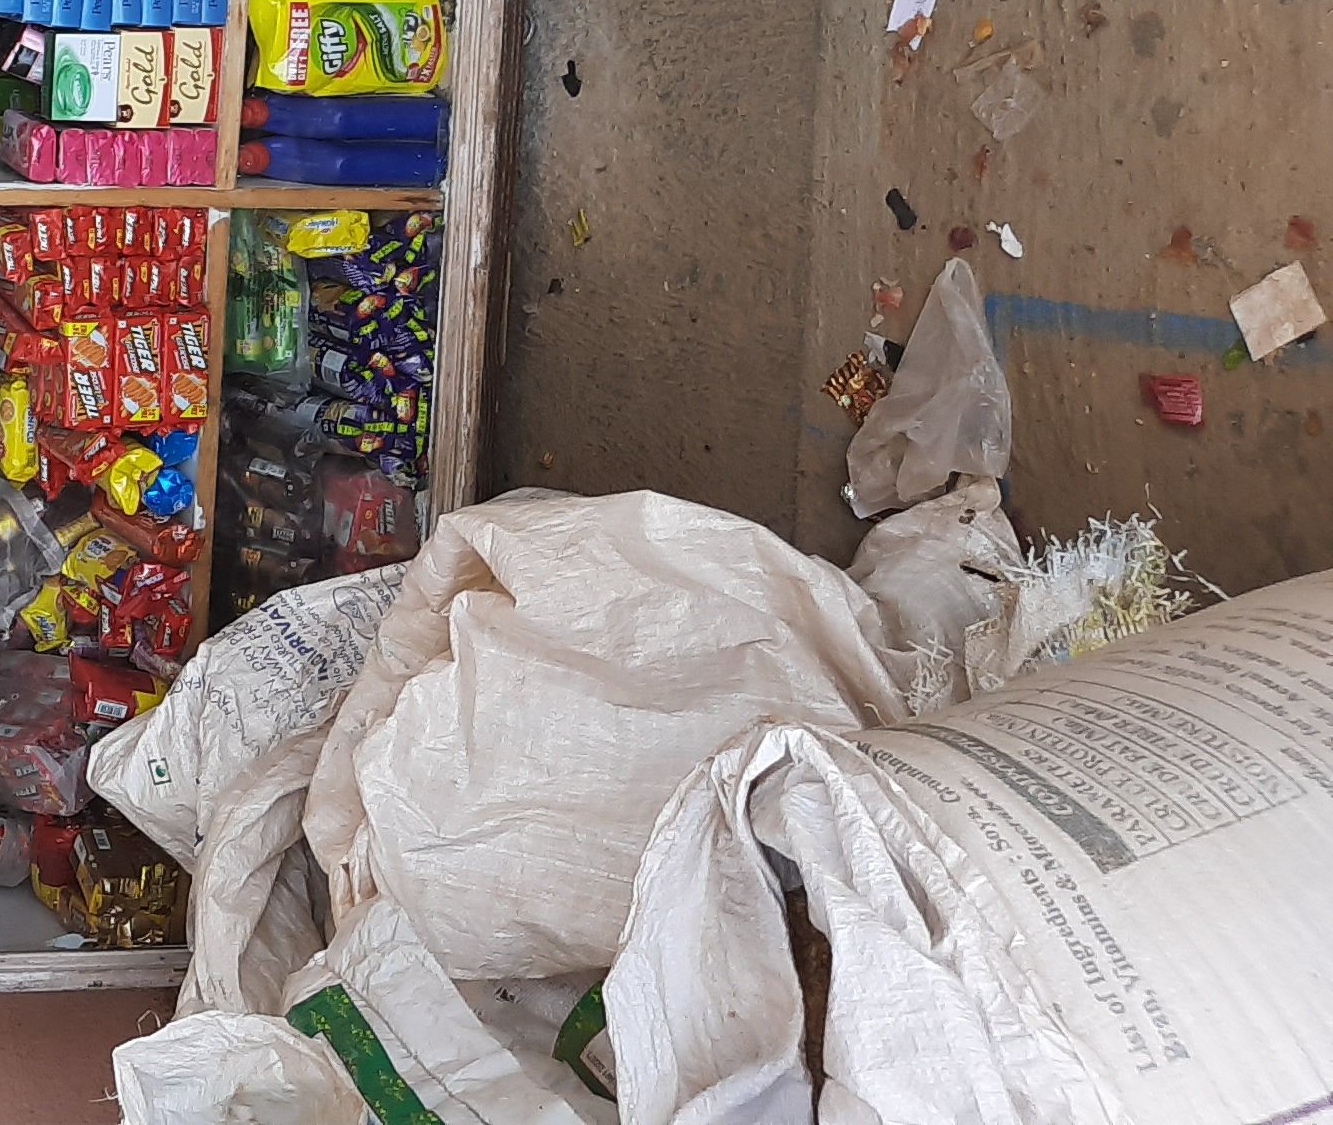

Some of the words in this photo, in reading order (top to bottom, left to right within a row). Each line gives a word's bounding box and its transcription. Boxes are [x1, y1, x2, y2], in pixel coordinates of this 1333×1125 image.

[289, 8, 309, 49] FREE
[317, 19, 348, 75] Giffy
[369, 13, 386, 33] SALT
[103, 41, 116, 81] Pears
[131, 45, 159, 105] Gold
[179, 41, 206, 100] Gold
[3, 241, 15, 271] TIGER
[37, 221, 49, 251] TIGER
[130, 325, 157, 373] TIGER
[181, 321, 208, 369] TIGER
[74, 371, 100, 419] TIGER
[259, 601, 313, 656] PRIVAT
[1018, 747, 1159, 848] PARAMETERS
[1056, 873, 1079, 891] &
[1023, 868, 1103, 985] Ingredients
[1069, 892, 1140, 993] Vitamins
[1093, 991, 1126, 1015] of
[1120, 1023, 1159, 1073] List
